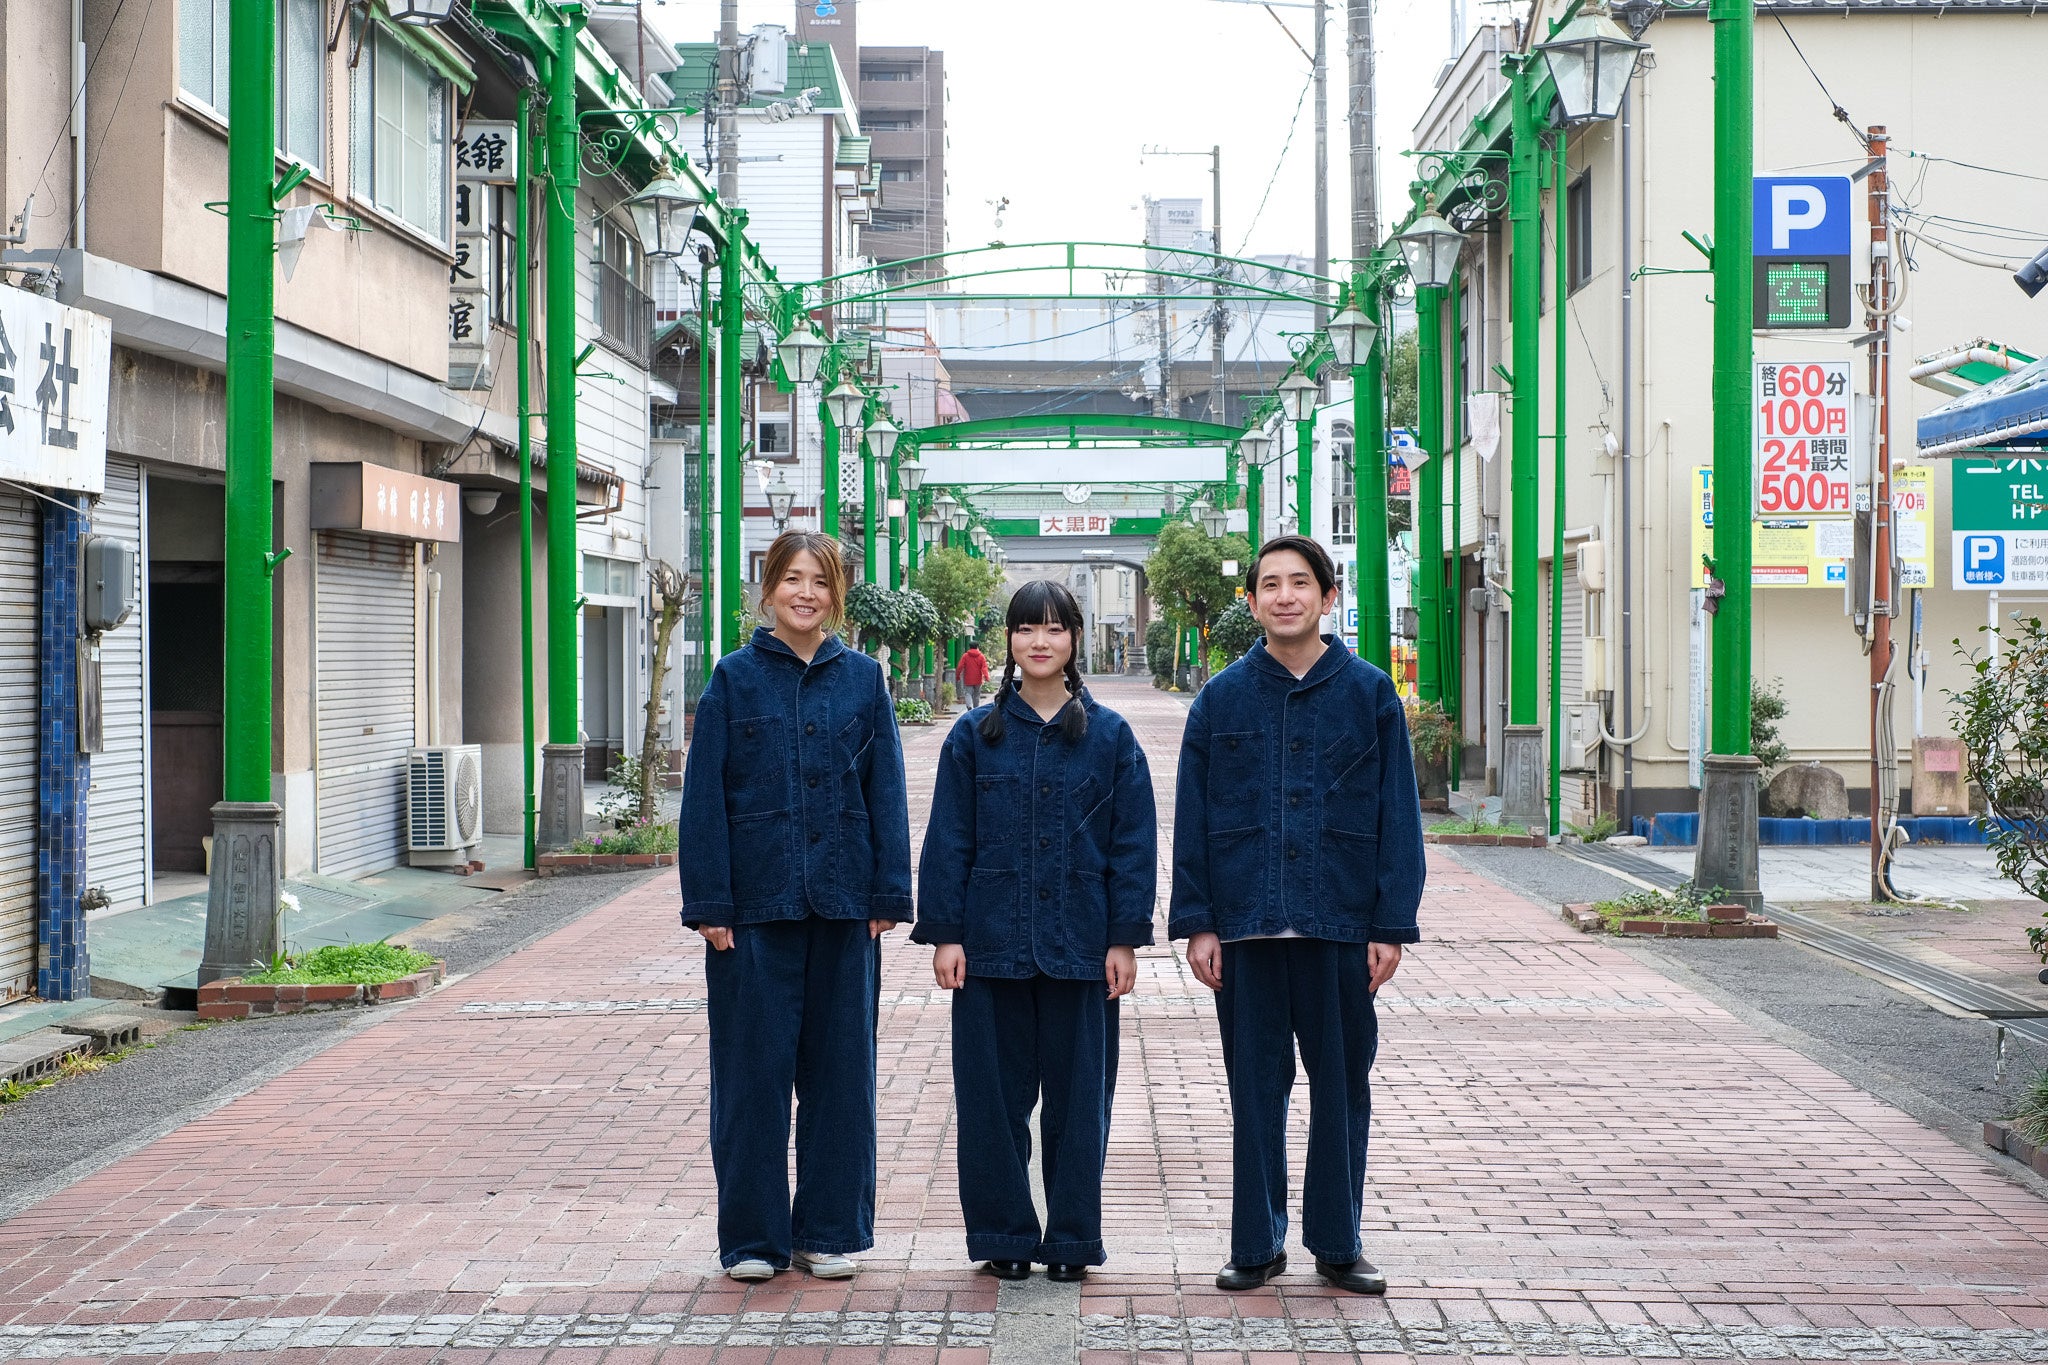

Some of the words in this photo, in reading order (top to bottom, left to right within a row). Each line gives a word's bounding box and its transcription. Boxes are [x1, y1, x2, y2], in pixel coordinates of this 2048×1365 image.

[1772, 185, 1826, 249] P
[1768, 263, 1829, 321] 空
[1761, 399, 1846, 435] 100円
[1761, 473, 1849, 511] 500円
[1892, 492, 1925, 510] 70円
[2009, 484, 2044, 500] TEL
[1044, 516, 1107, 533] 大黒町
[1970, 538, 1998, 569] P
[1966, 571, 2003, 581] 患者様へ
